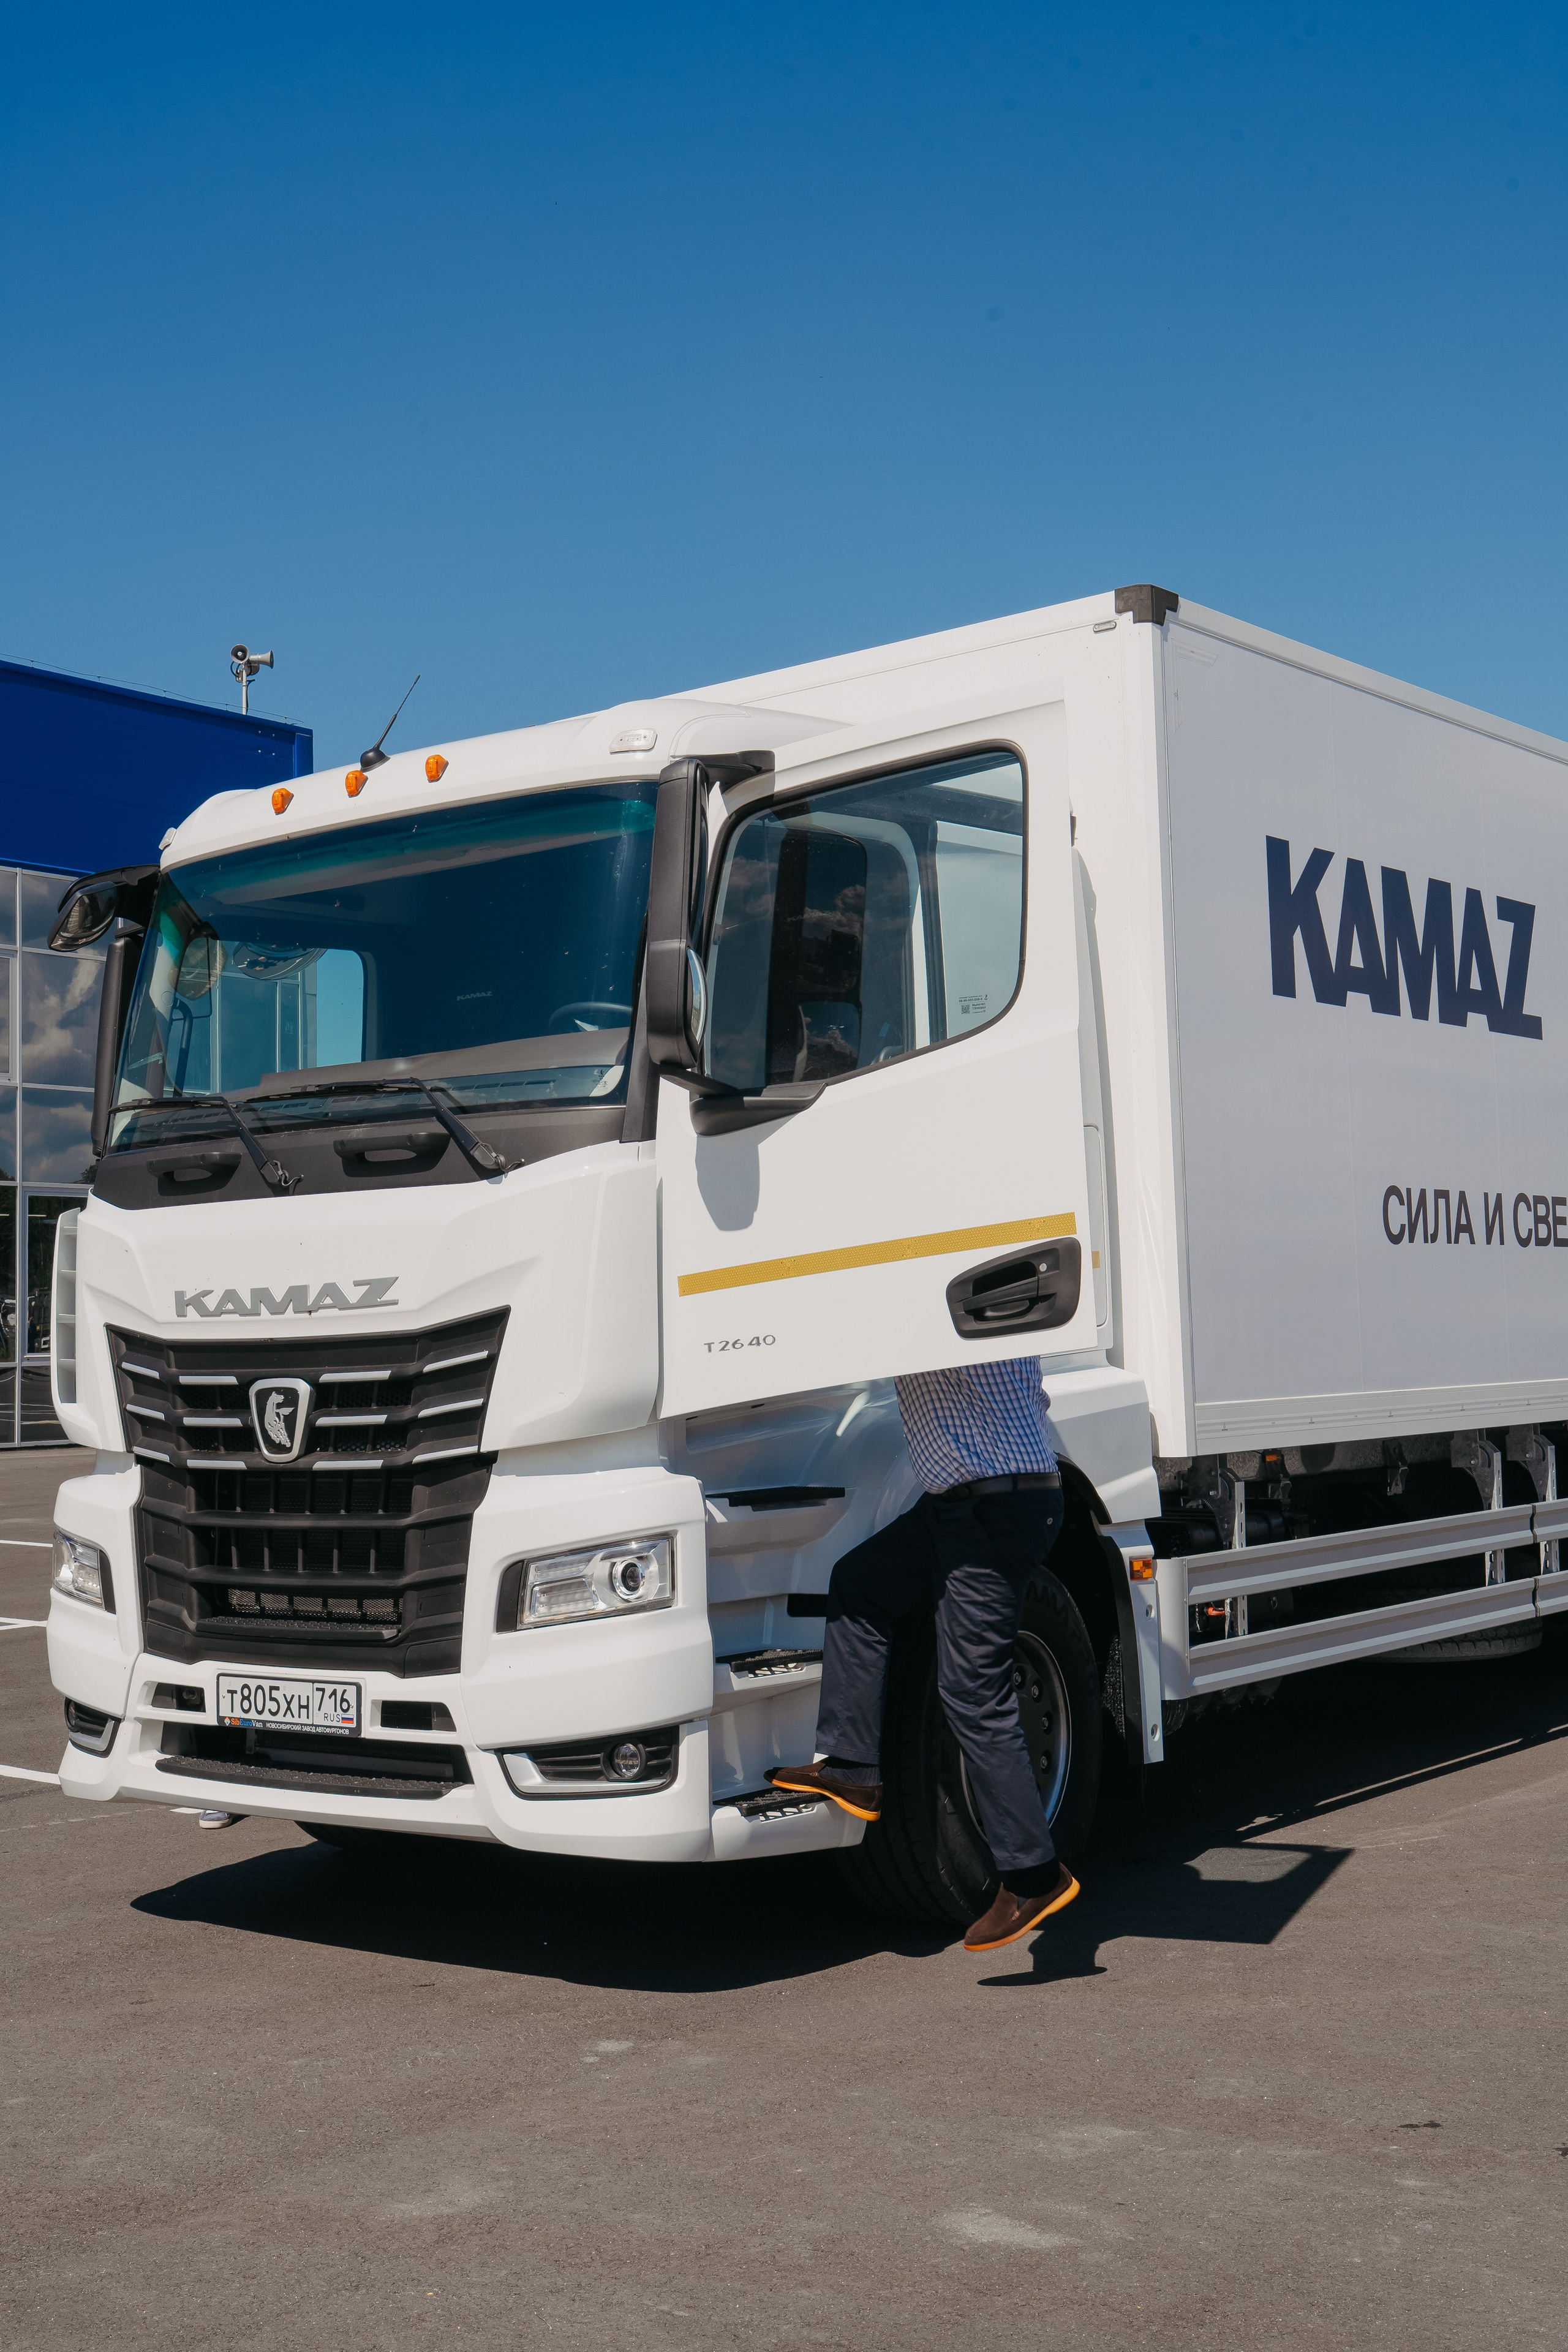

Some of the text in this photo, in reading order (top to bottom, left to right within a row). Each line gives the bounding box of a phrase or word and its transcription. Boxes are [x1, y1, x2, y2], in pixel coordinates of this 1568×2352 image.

[1265, 835, 1543, 1040] KAMAZ
[457, 991, 492, 1001] KAMAZ
[1382, 1185, 1568, 1248] СИЛА И СВЕ
[175, 1276, 399, 1317] KAMAZ
[704, 1335, 775, 1353] T2640
[1025, 1580, 1068, 1630] AMA
[227, 1683, 350, 1719] Т805ХН 716
[324, 1713, 340, 1722] RUS
[231, 1718, 263, 1727] SibEuroVan
[266, 1722, 301, 1731] НОВОСИБИРСКИЙ
